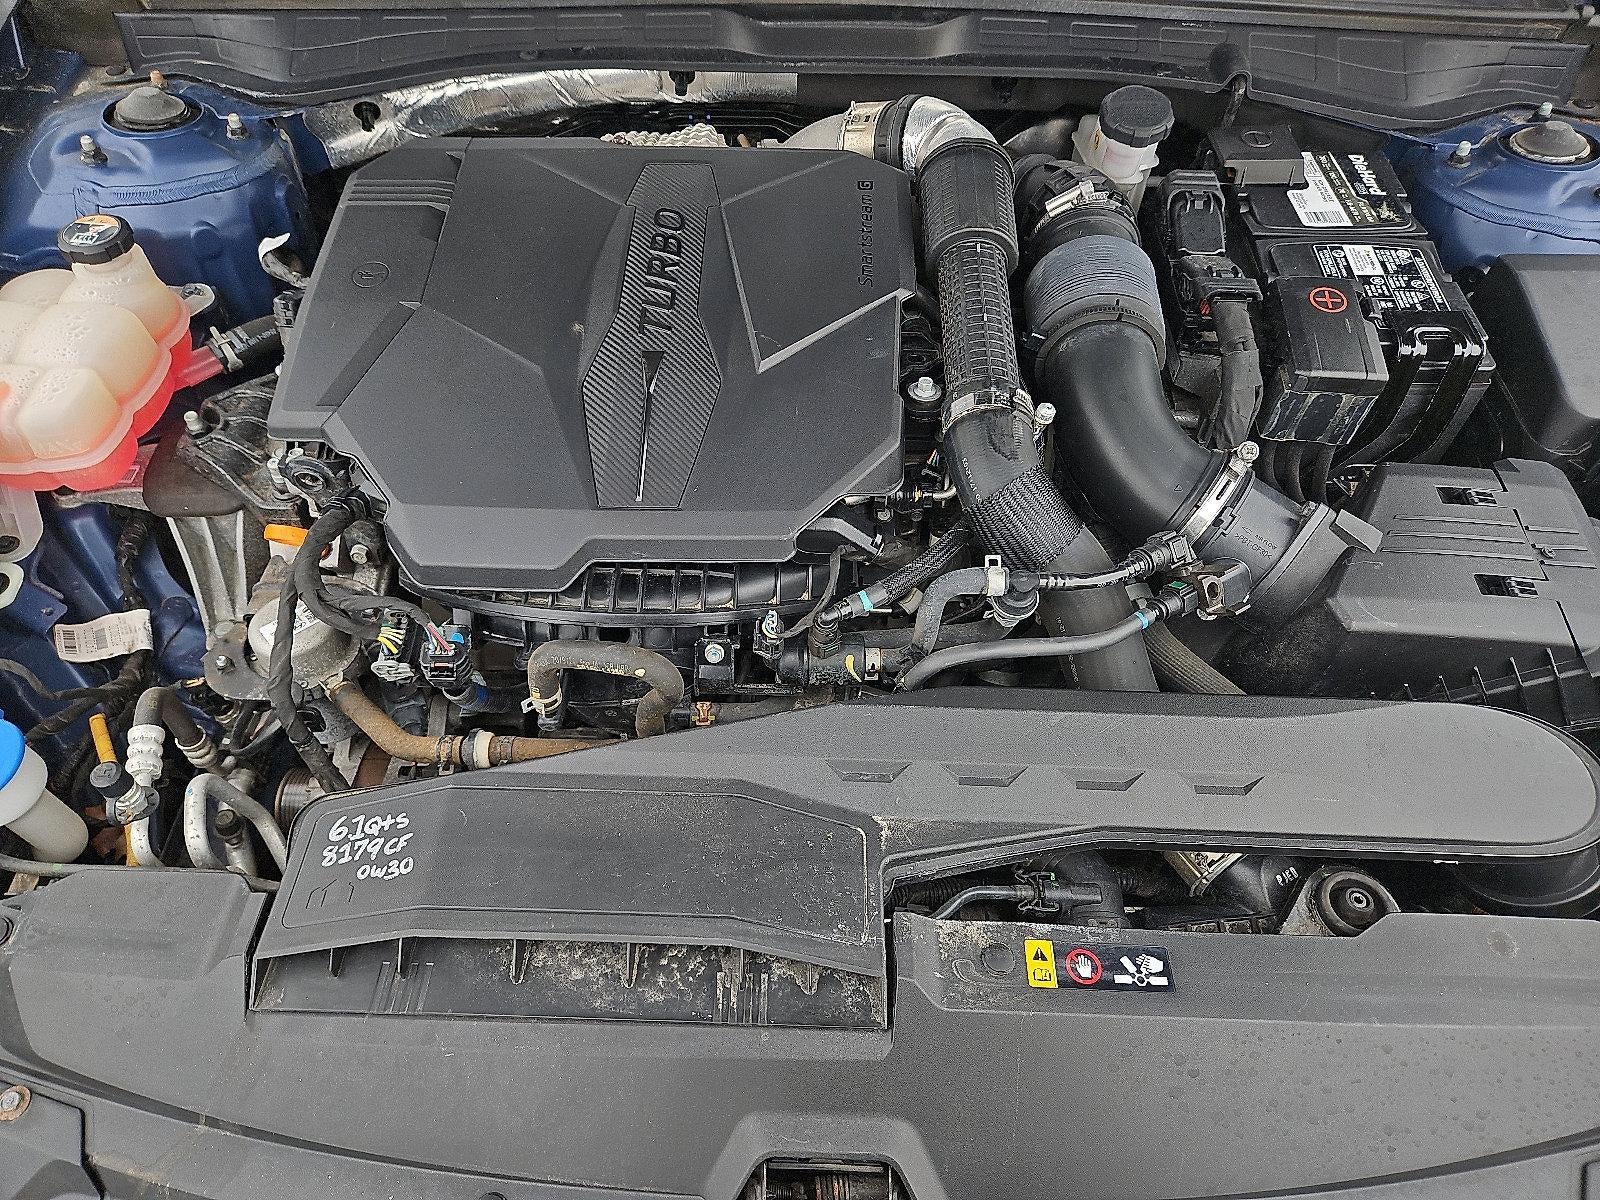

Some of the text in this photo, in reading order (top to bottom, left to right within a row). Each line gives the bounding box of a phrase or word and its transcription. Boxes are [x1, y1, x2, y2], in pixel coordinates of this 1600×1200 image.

[1347, 154, 1387, 196] DieHard
[638, 207, 686, 336] TURBO
[857, 180, 874, 288] Smartstream G
